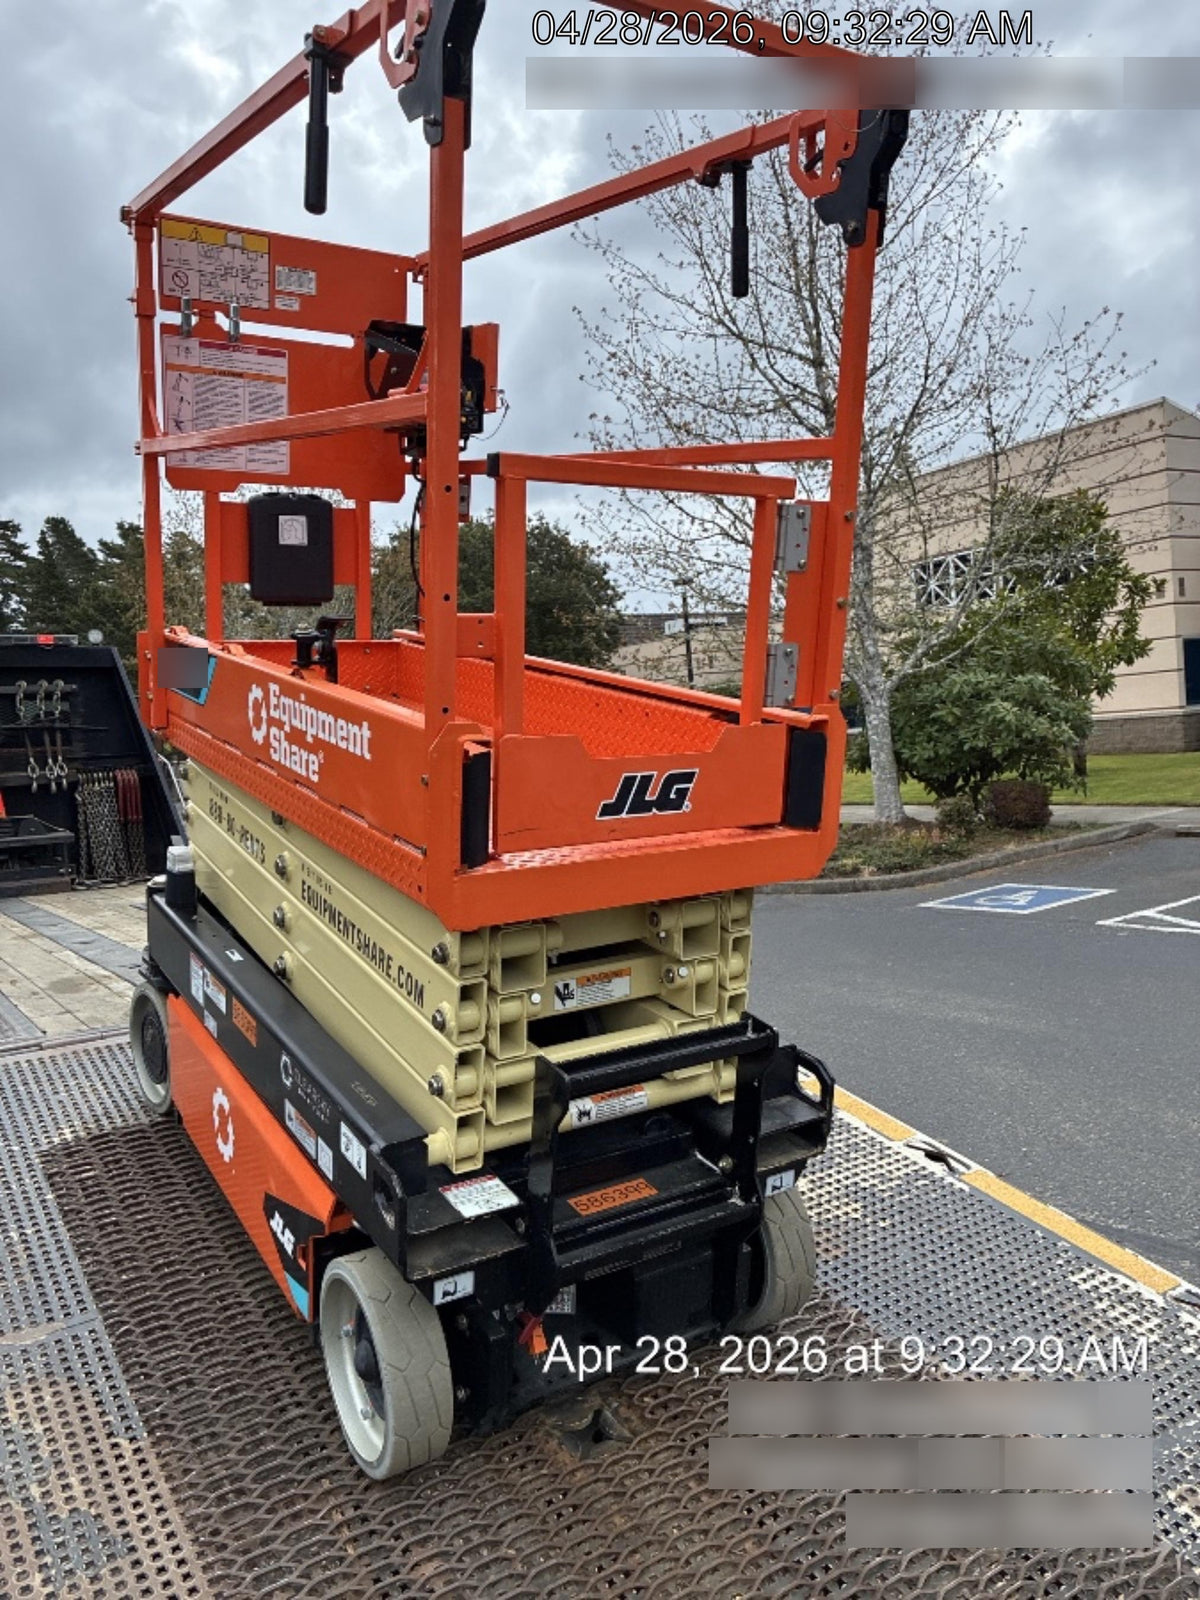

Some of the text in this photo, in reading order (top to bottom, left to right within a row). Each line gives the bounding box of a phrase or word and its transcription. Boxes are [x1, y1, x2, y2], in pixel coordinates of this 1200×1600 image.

[269, 683, 371, 759] Equipment
[595, 768, 699, 820] JLG
[301, 879, 425, 1008] EQUIPMENTSHARE.COM
